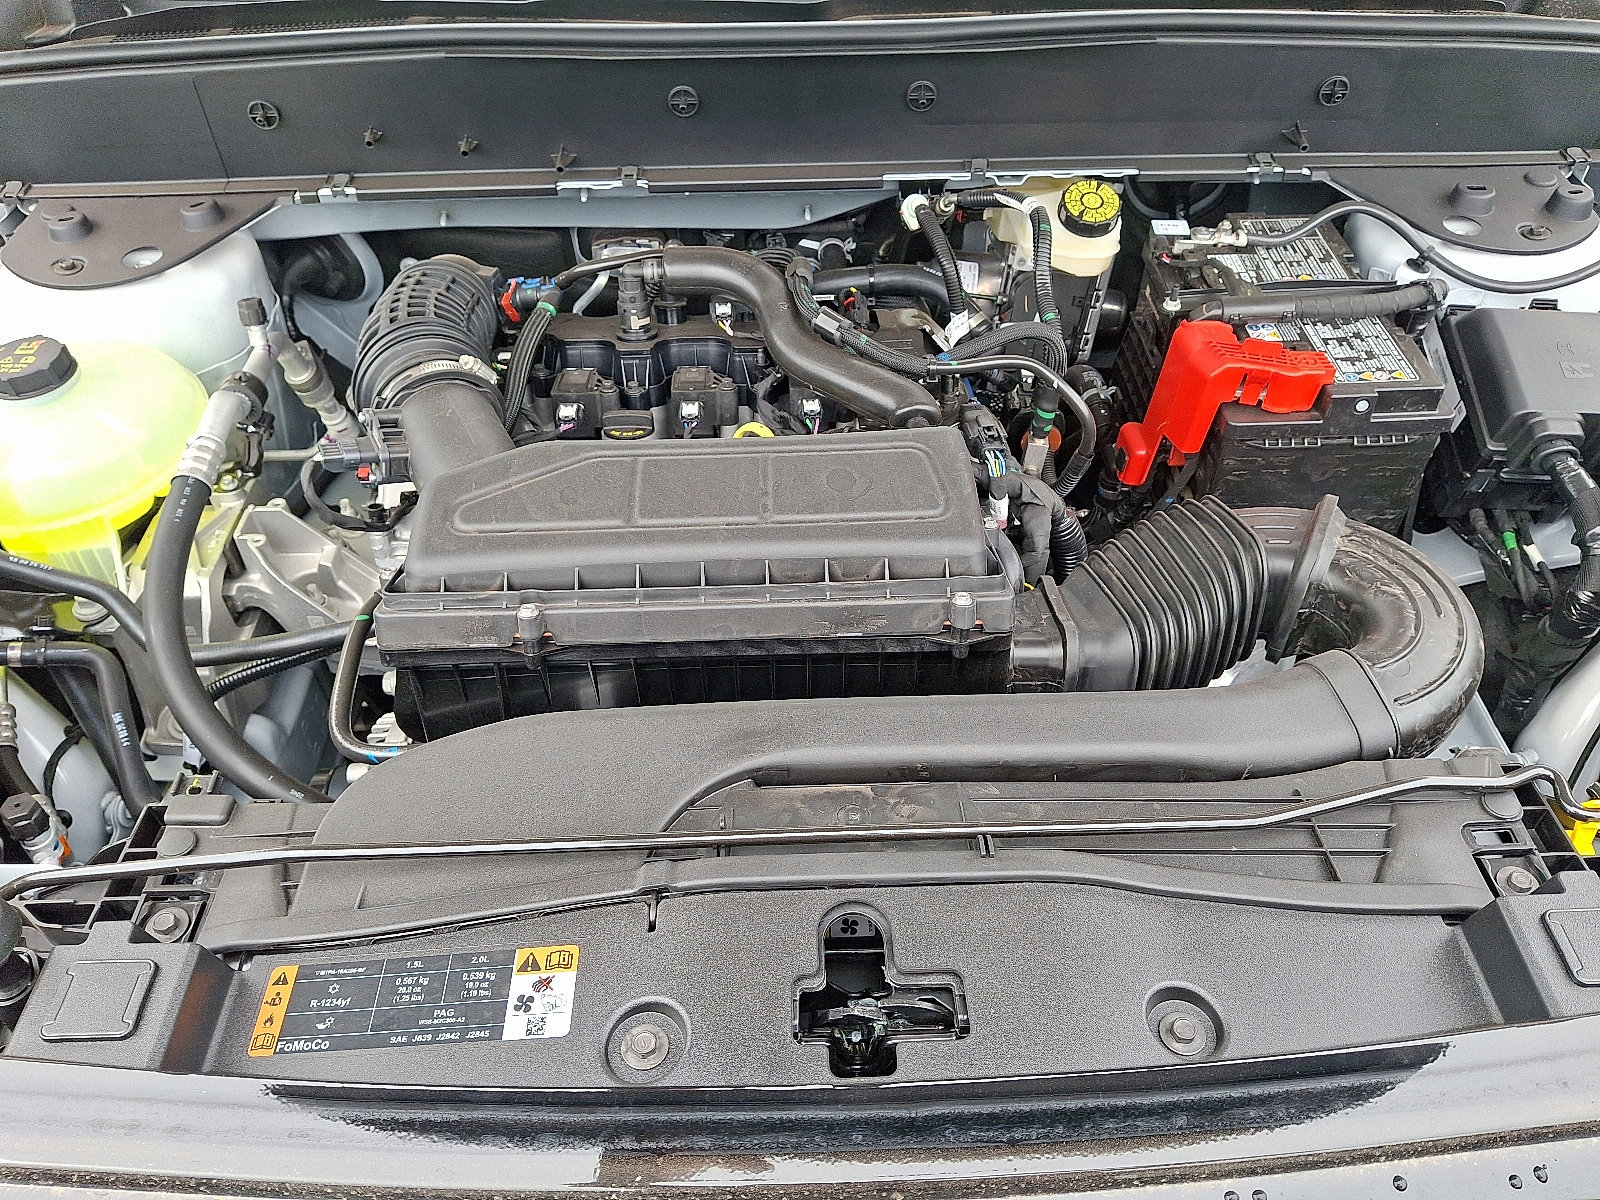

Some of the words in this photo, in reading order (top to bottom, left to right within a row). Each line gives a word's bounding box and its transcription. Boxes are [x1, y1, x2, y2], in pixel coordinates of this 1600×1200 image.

[470, 955, 490, 964] 2.0L
[405, 960, 424, 969] 1.5L
[485, 971, 496, 980] kg
[395, 976, 418, 986] 0.567
[419, 975, 430, 986] kg
[310, 997, 352, 1008] R-1234yf
[433, 1009, 455, 1018] PAG
[389, 1034, 409, 1044] SAE
[276, 1039, 330, 1052] FoMoCo
